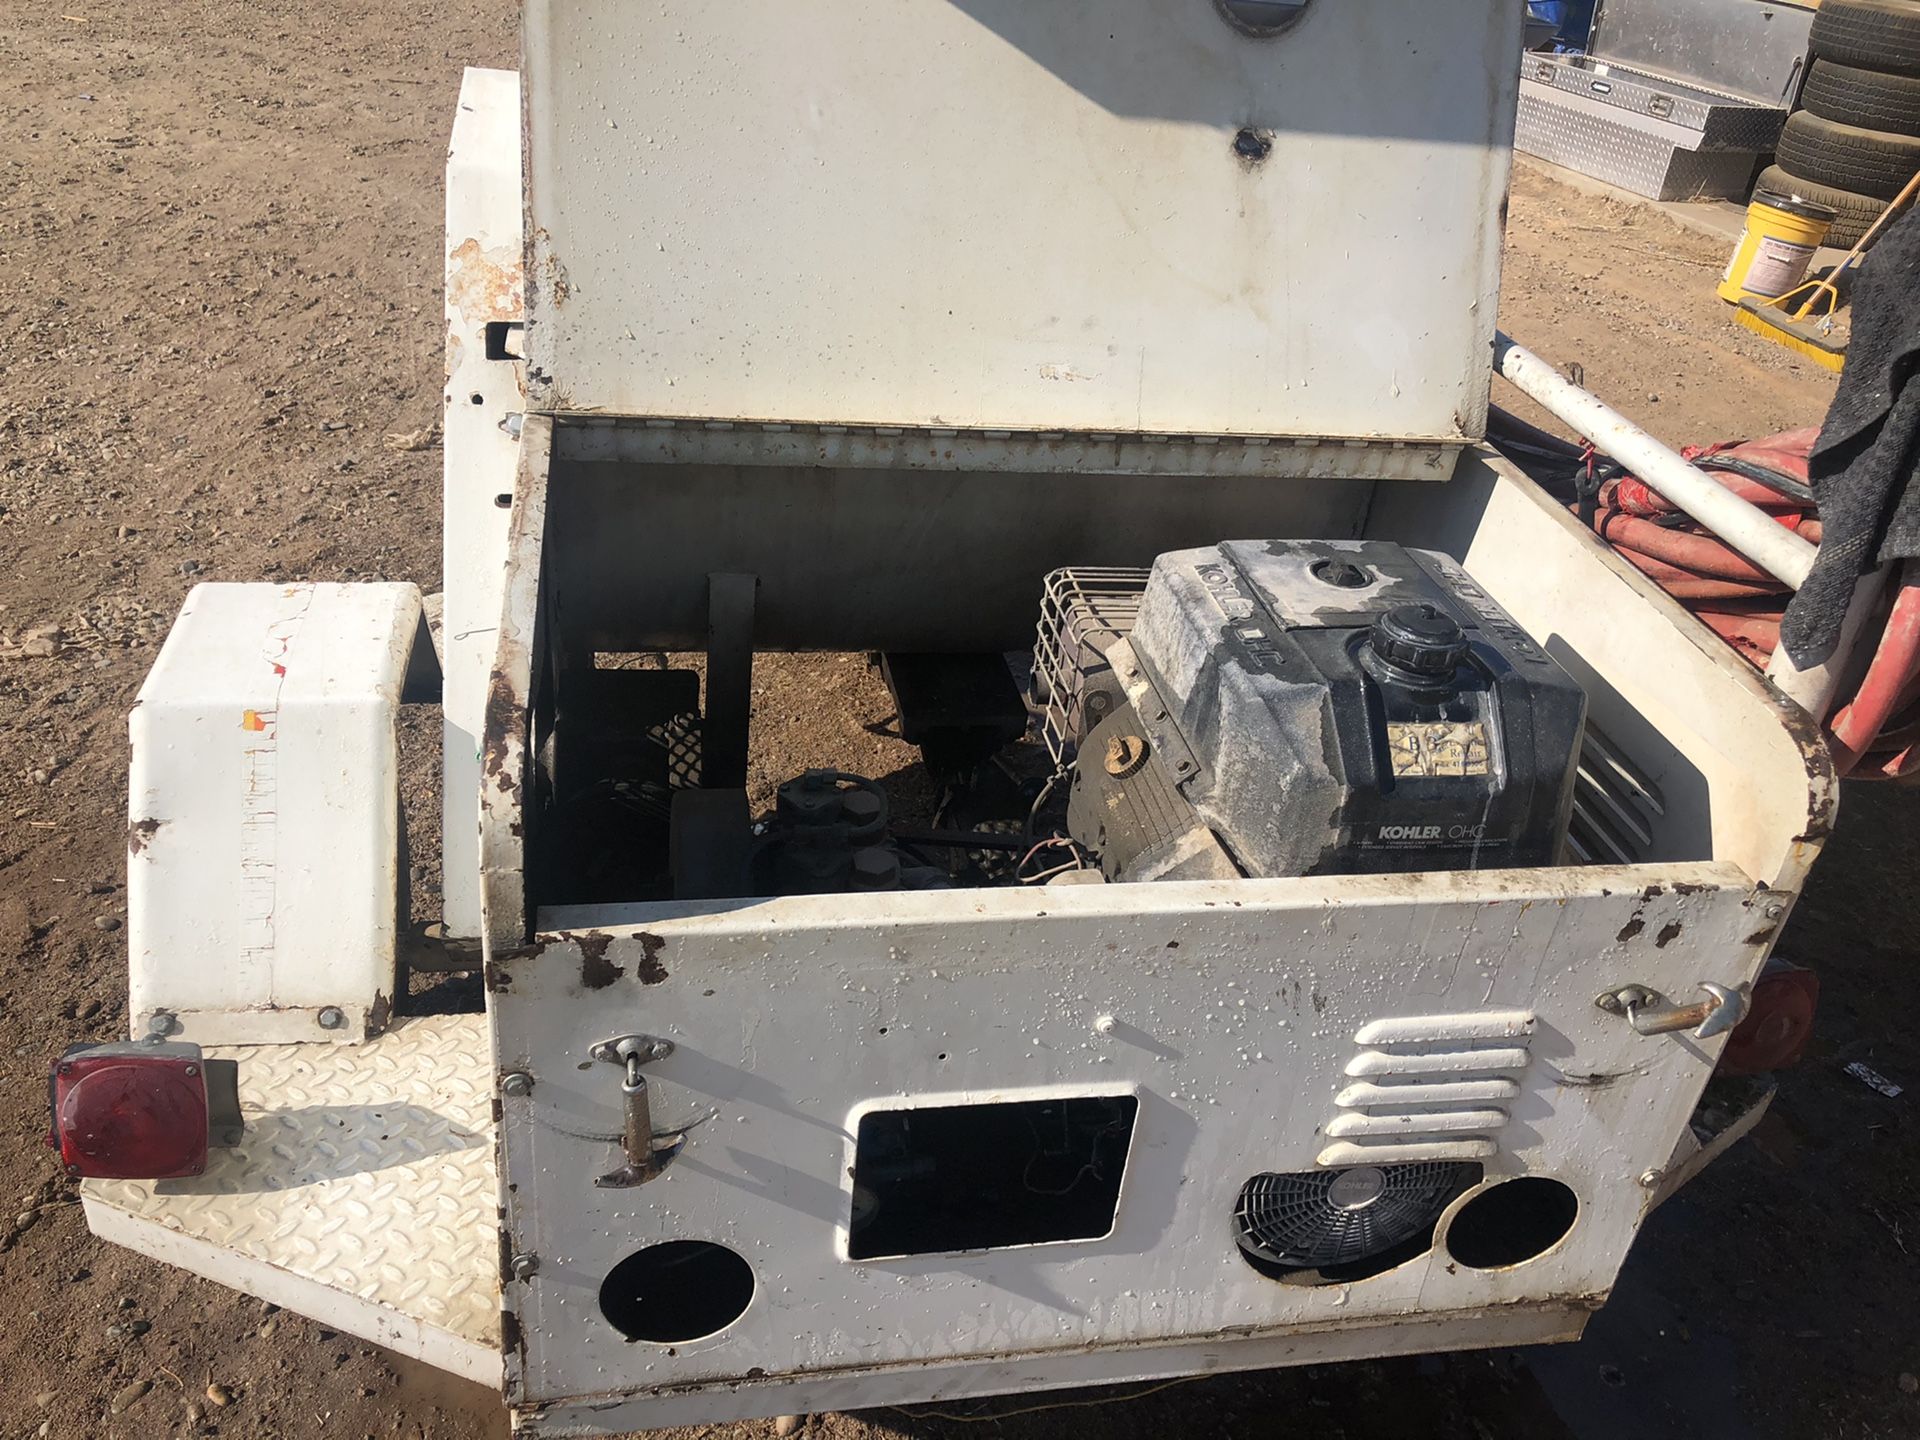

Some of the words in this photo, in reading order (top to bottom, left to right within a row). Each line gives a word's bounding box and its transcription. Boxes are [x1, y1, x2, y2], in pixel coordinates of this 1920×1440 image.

[1194, 564, 1254, 622] KOHLER
[1234, 627, 1286, 668] OHC
[1378, 826, 1442, 840] KOHLER
[1448, 825, 1487, 839] OHC
